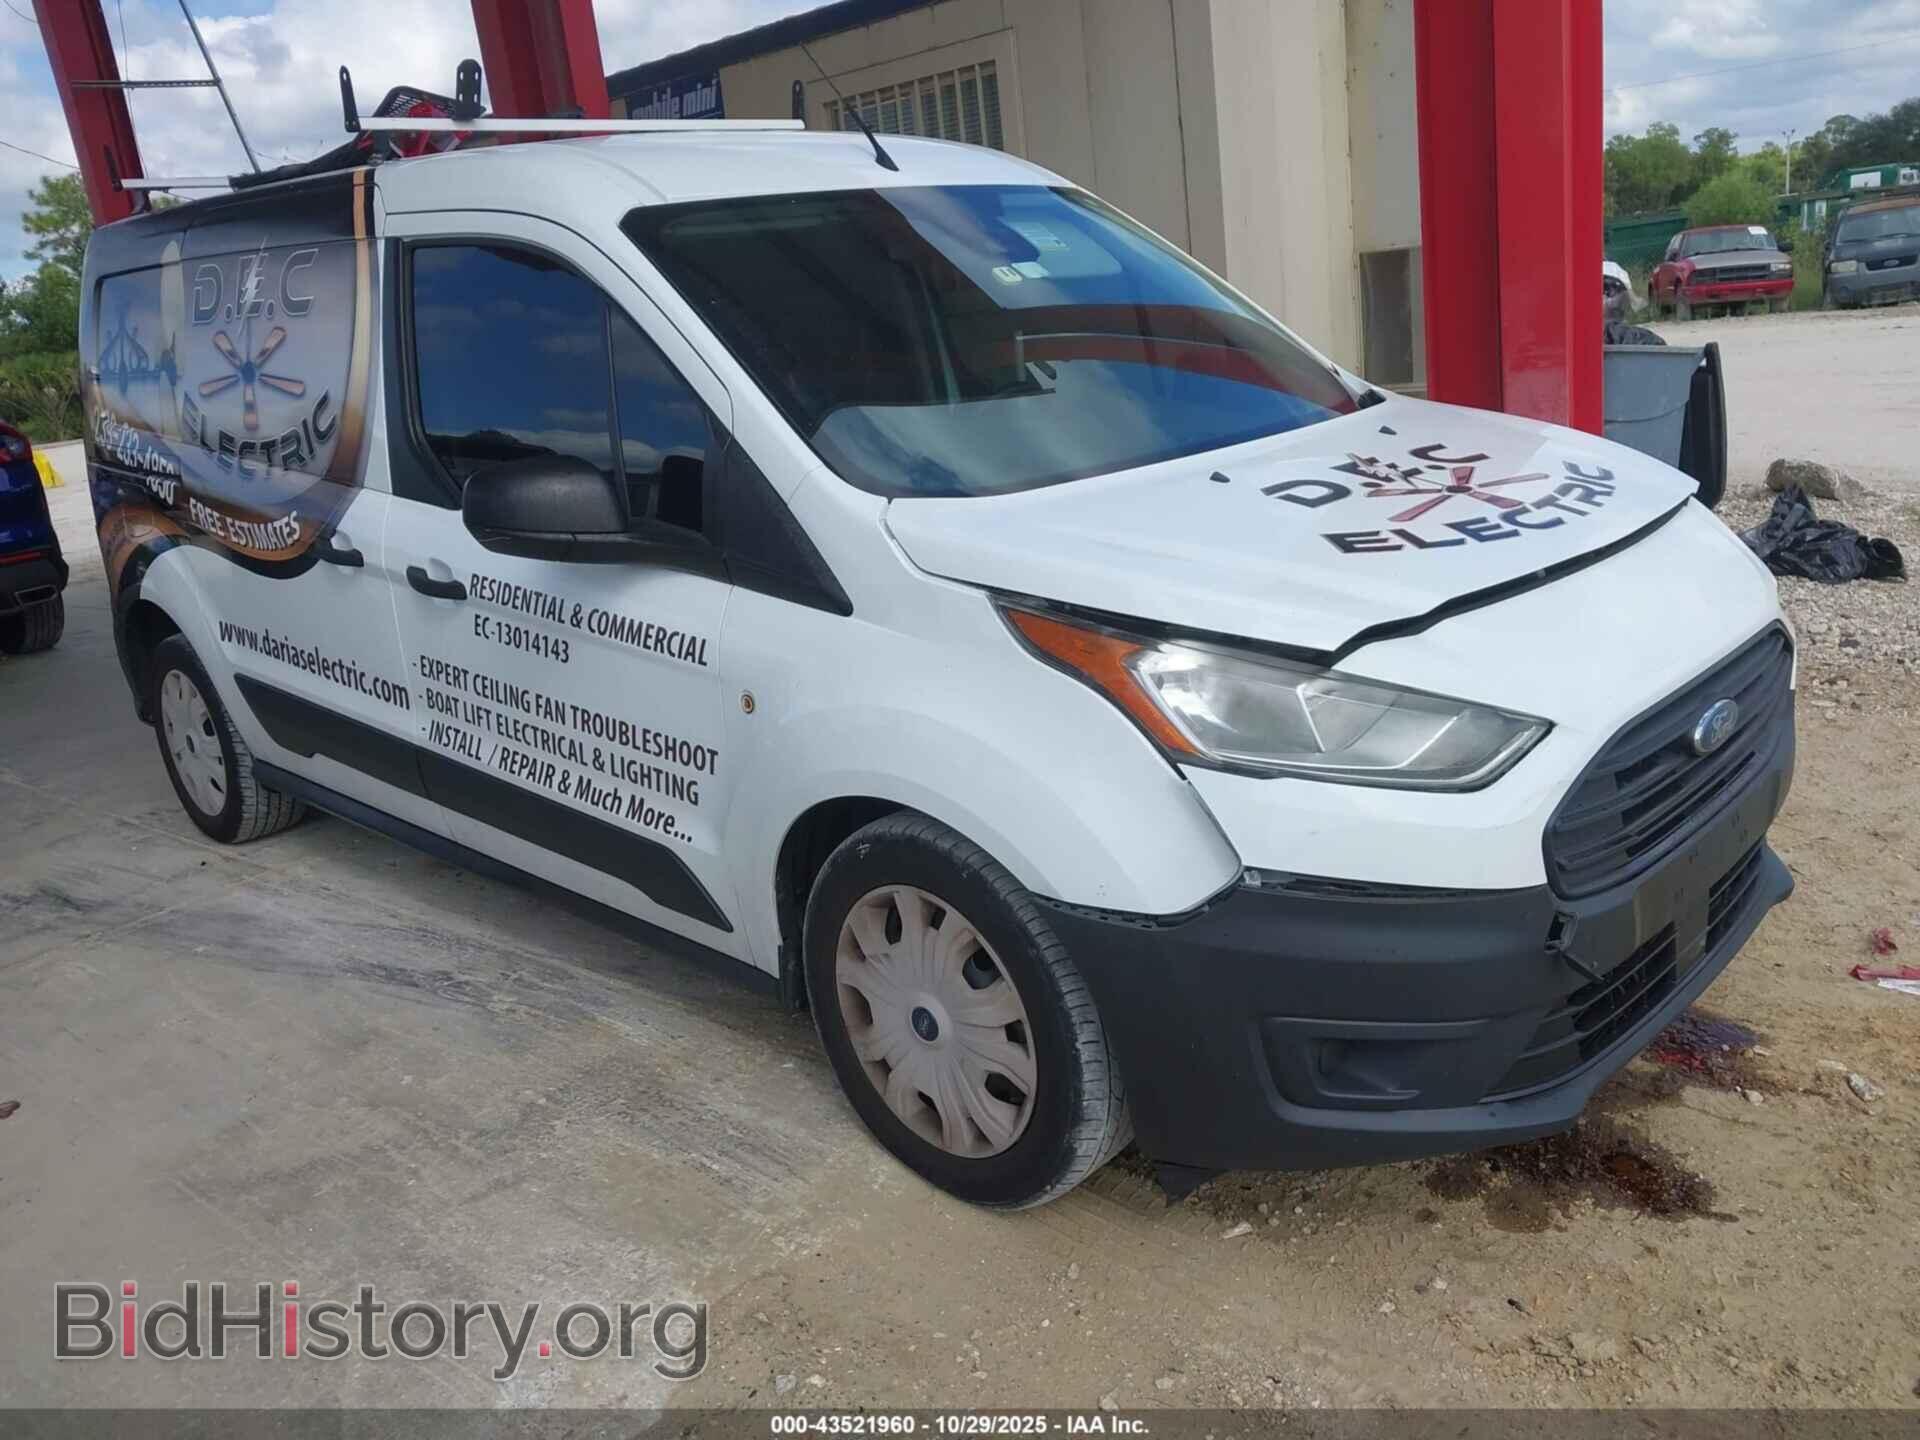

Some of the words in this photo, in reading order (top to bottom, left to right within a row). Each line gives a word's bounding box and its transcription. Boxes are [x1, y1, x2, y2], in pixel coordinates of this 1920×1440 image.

[682, 79, 717, 116] mini
[183, 387, 337, 480] ELECTRIC
[189, 497, 225, 537] FREE
[227, 510, 301, 550] ESTIMATES
[1320, 460, 1617, 553] ELECTRIC
[218, 620, 411, 711] www.dariaselectric.com
[469, 573, 566, 624] RESIDENTIAL
[570, 602, 584, 629] &
[587, 608, 708, 666] COMMERCIAL
[474, 613, 570, 663] EC-13014143
[420, 654, 470, 692] EXPERT
[473, 673, 531, 714] CEILING
[535, 693, 566, 726] FAN
[570, 704, 719, 776] TROUBLESHOOT
[426, 687, 460, 719] BOAT
[463, 702, 493, 731] LIFT
[496, 713, 589, 767] ELECTRICAL
[592, 747, 606, 773] &
[610, 752, 700, 806] LIGHTING
[428, 719, 483, 761] INSTALL
[498, 747, 556, 790] REPAIR
[557, 769, 572, 795] &
[574, 775, 622, 815] Much
[625, 794, 693, 843] More...
